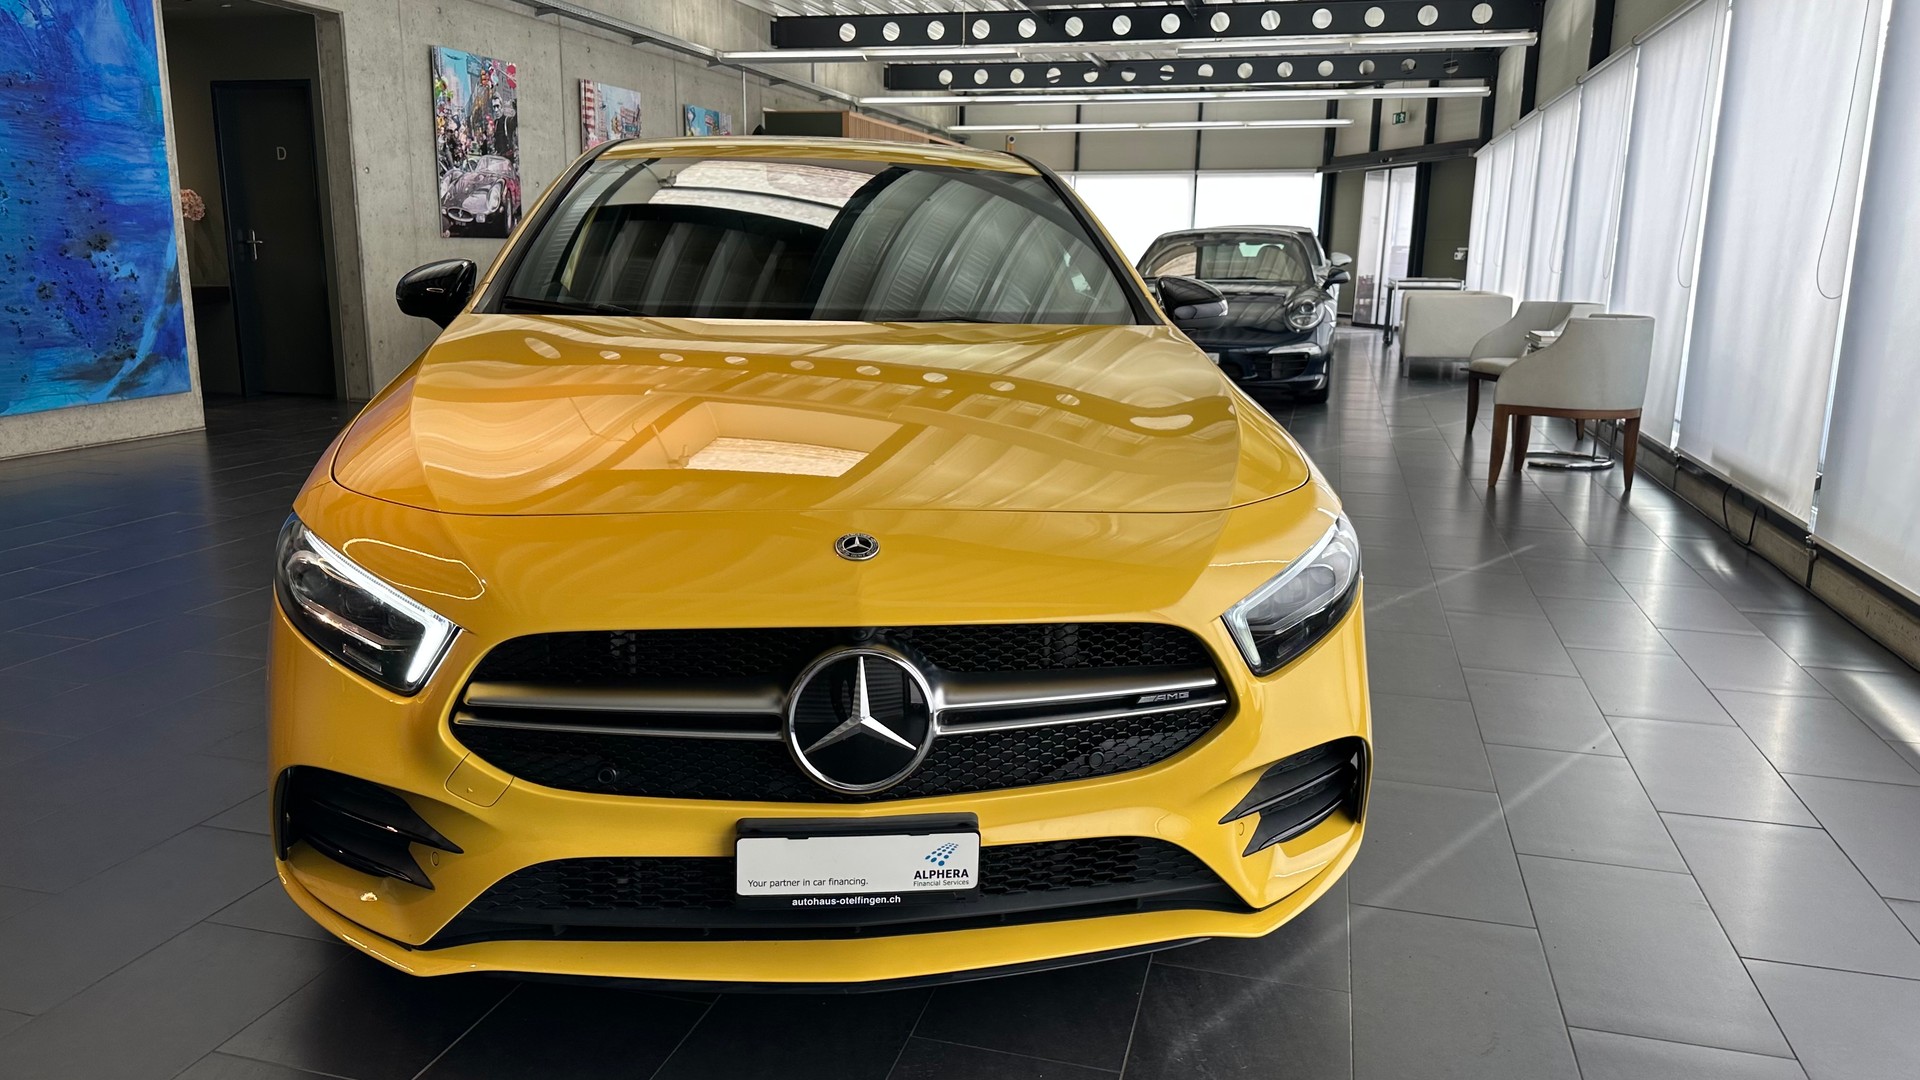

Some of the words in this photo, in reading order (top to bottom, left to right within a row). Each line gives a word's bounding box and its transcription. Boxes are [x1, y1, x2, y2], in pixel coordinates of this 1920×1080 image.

[276, 146, 287, 160] D
[1154, 691, 1190, 702] AMG
[913, 868, 969, 880] ALPHERA
[747, 879, 767, 888] Your
[769, 879, 800, 889] partner
[802, 878, 811, 887] in
[828, 877, 869, 887] financing.
[913, 879, 941, 887] Financial
[791, 895, 901, 906] autohaus-otelfingen.ch
